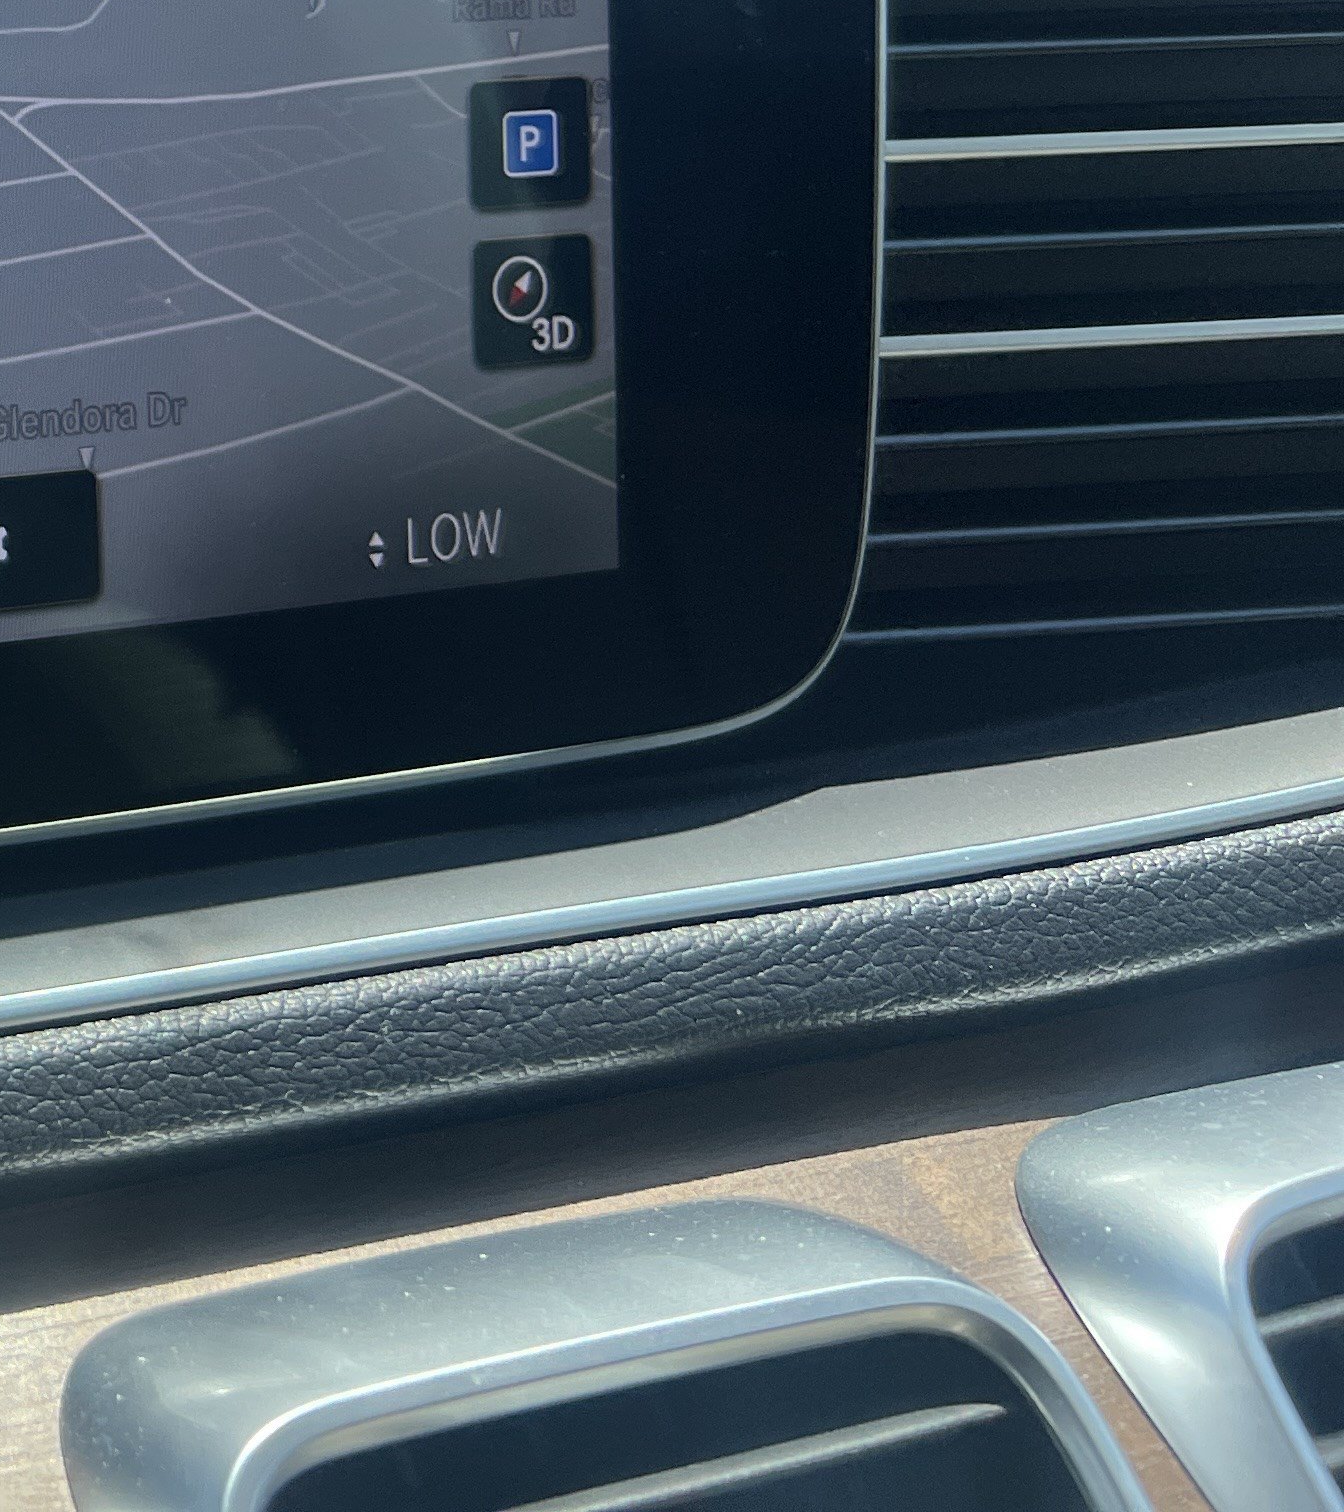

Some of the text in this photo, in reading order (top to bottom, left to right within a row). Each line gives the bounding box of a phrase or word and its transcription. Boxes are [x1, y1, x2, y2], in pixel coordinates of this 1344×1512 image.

[519, 125, 541, 162] P
[530, 315, 576, 351] 3D
[147, 392, 188, 428] Dr
[406, 508, 502, 566] LOW
